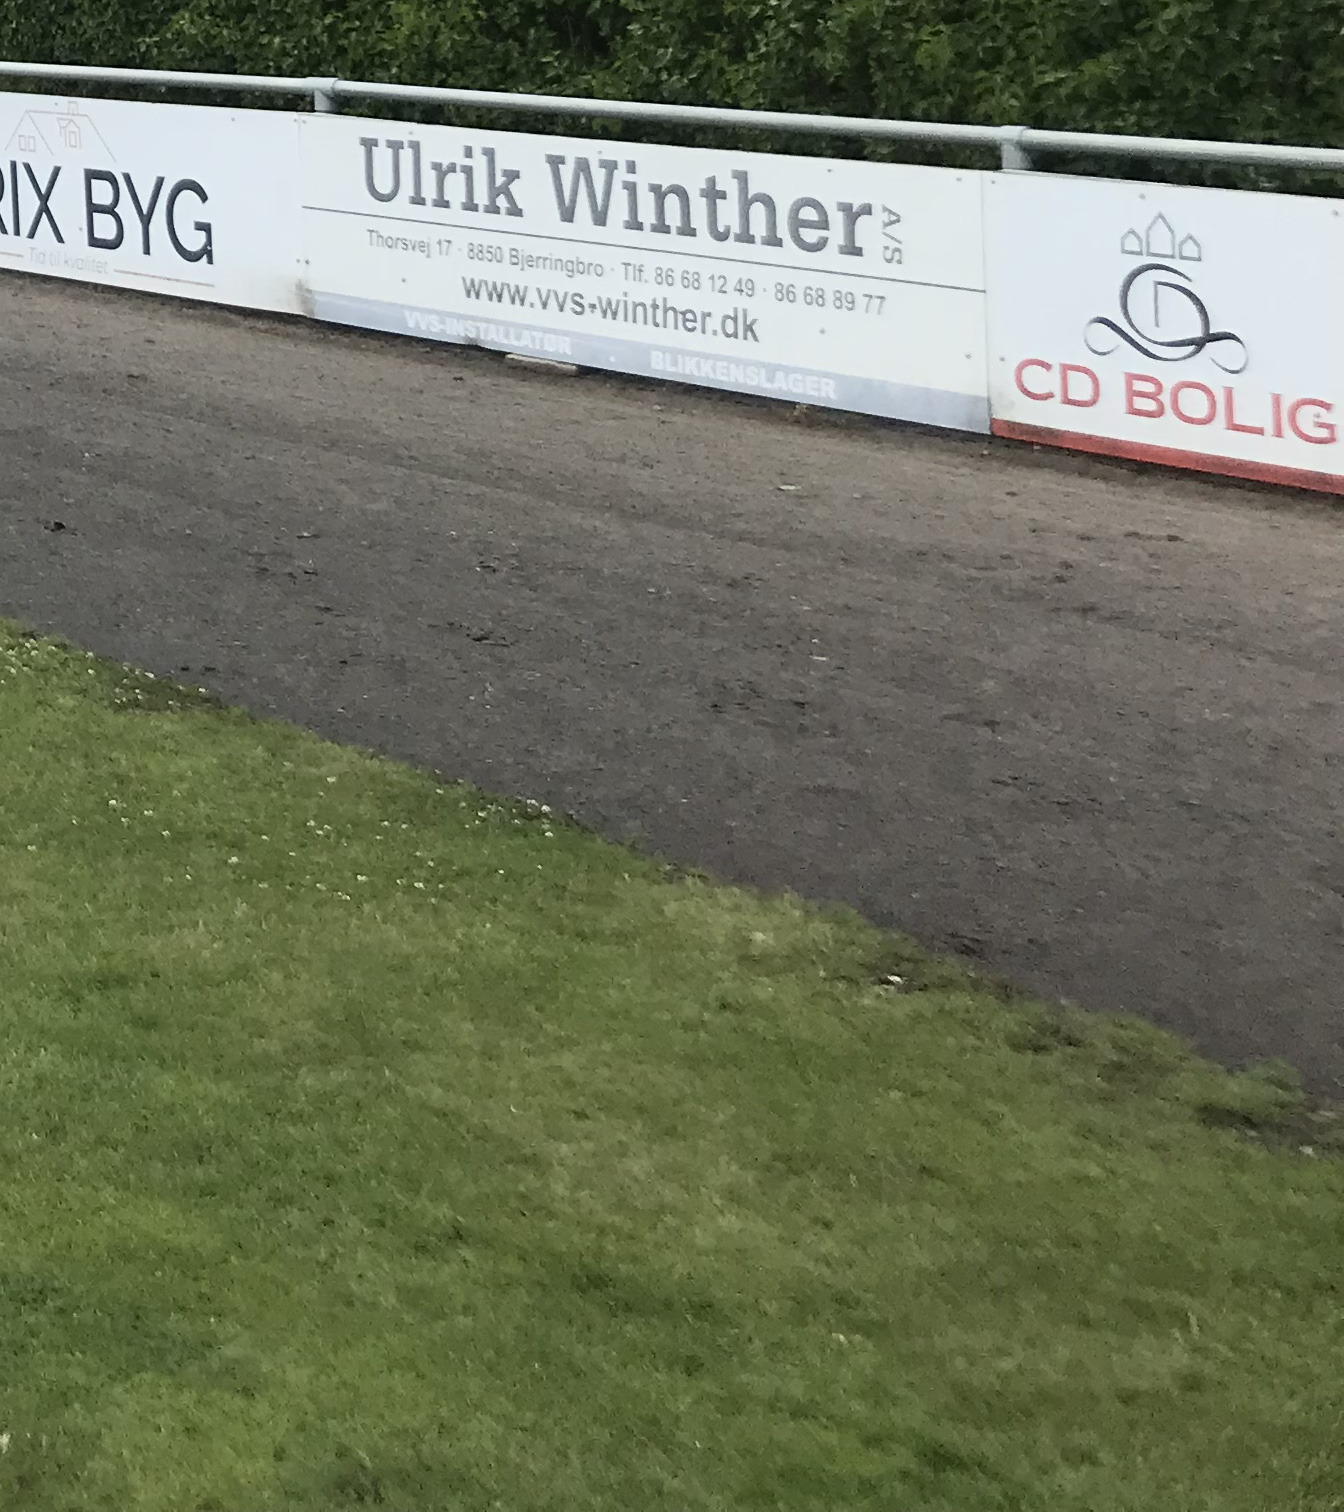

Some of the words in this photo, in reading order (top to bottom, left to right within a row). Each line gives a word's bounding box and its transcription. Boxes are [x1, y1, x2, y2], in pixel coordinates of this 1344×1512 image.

[83, 168, 214, 265] BYG
[359, 136, 524, 218] Ulrik
[544, 153, 873, 258] Winther
[880, 203, 904, 266] A/S
[28, 246, 46, 264] Tid
[49, 249, 61, 266] til
[63, 252, 109, 275] kvalitet
[366, 228, 432, 258] Thorsvej
[435, 239, 453, 256] 17
[467, 241, 504, 264] 8850
[508, 247, 605, 278] Bjerringbro
[621, 261, 649, 284] Tlf.
[654, 266, 675, 287] 86
[680, 270, 702, 291] 68
[708, 274, 728, 294] 12
[733, 278, 755, 298] 49
[774, 282, 798, 303] 86
[803, 286, 826, 308] 68
[832, 290, 856, 311] 89
[862, 293, 887, 316] 77
[461, 276, 760, 342] www.vvs-winther.dk
[650, 350, 838, 400] BLIKKENSLAGER
[1013, 357, 1101, 408] CD
[1124, 371, 1338, 445] BOLIG
